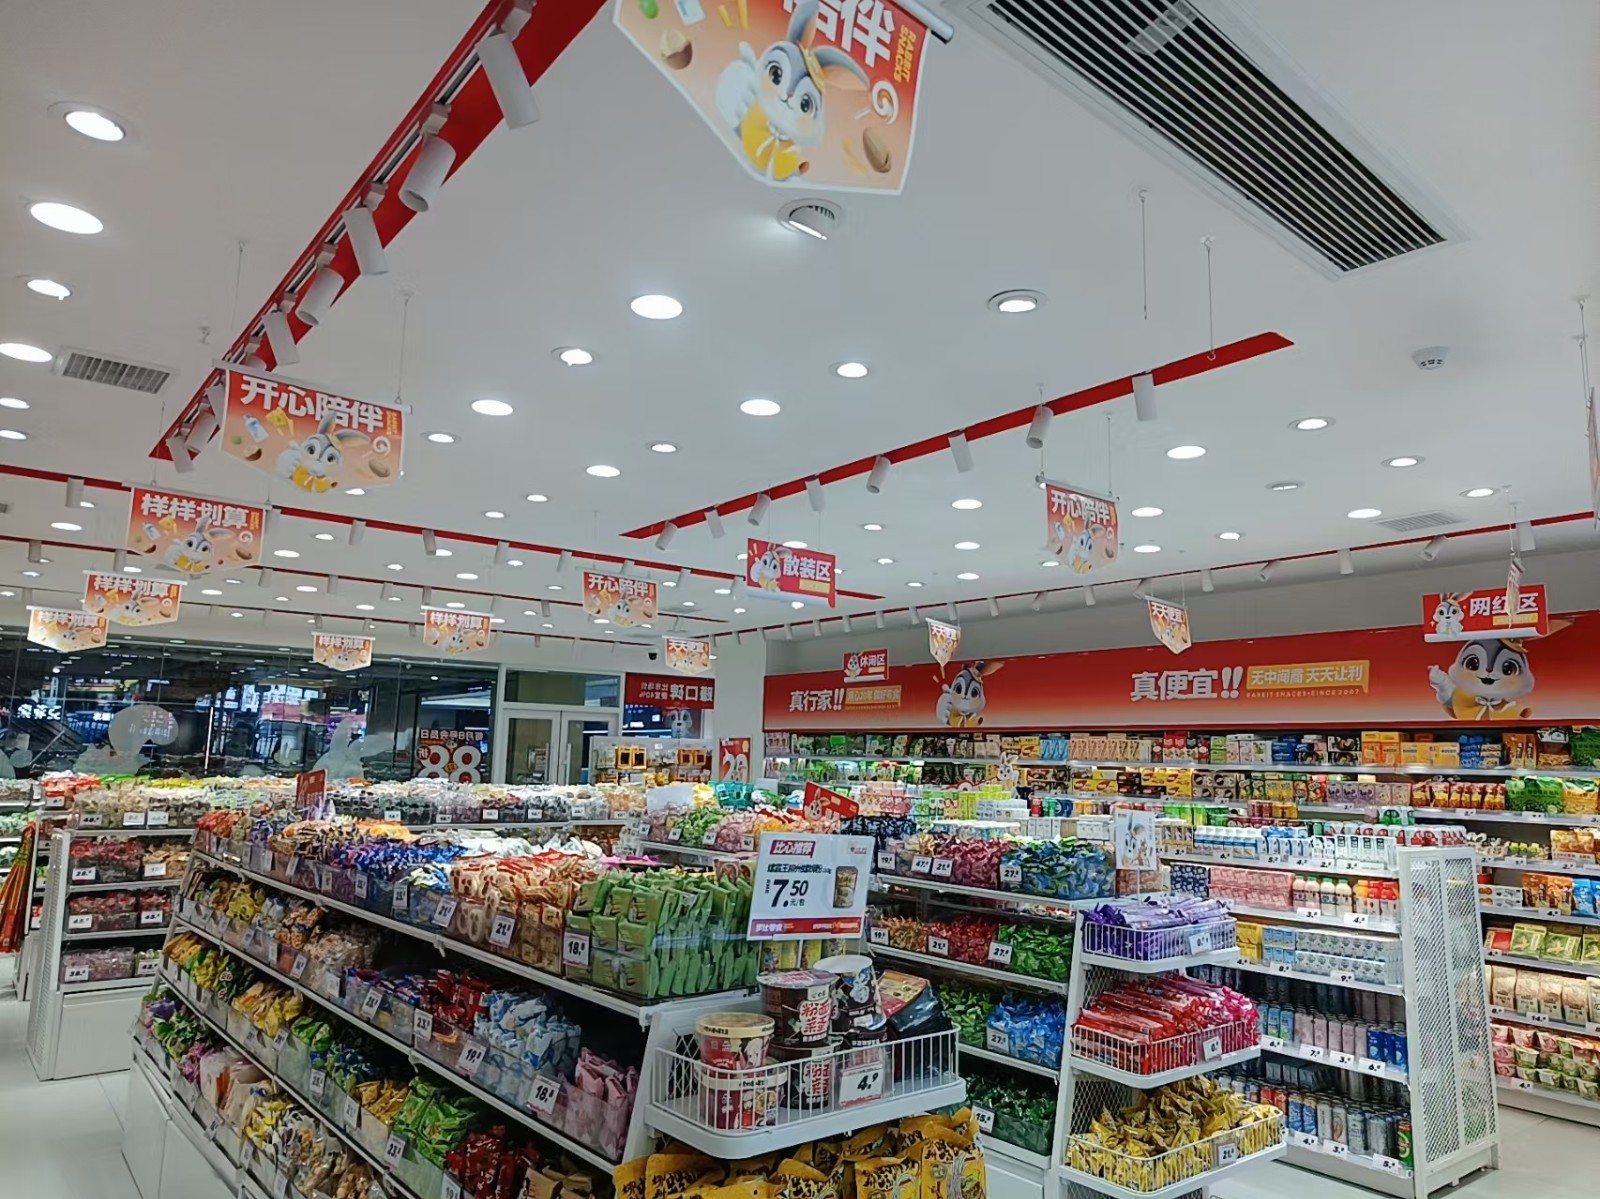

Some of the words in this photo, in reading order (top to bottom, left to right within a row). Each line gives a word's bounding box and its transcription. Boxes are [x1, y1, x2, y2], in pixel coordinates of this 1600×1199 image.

[240, 375, 383, 433] 开心陪伴
[140, 493, 250, 529] 样样划算
[1051, 489, 1111, 525] 开心陪伴
[783, 555, 832, 581] 散装区
[94, 575, 169, 598] 样样划算
[588, 574, 649, 596] 开心陪伴
[860, 653, 885, 667] 休闲区
[1251, 669, 1304, 685] 无中间商
[1306, 665, 1363, 682] 天天让利
[771, 879, 809, 908] 7.50
[857, 1073, 879, 1091] 4.9
